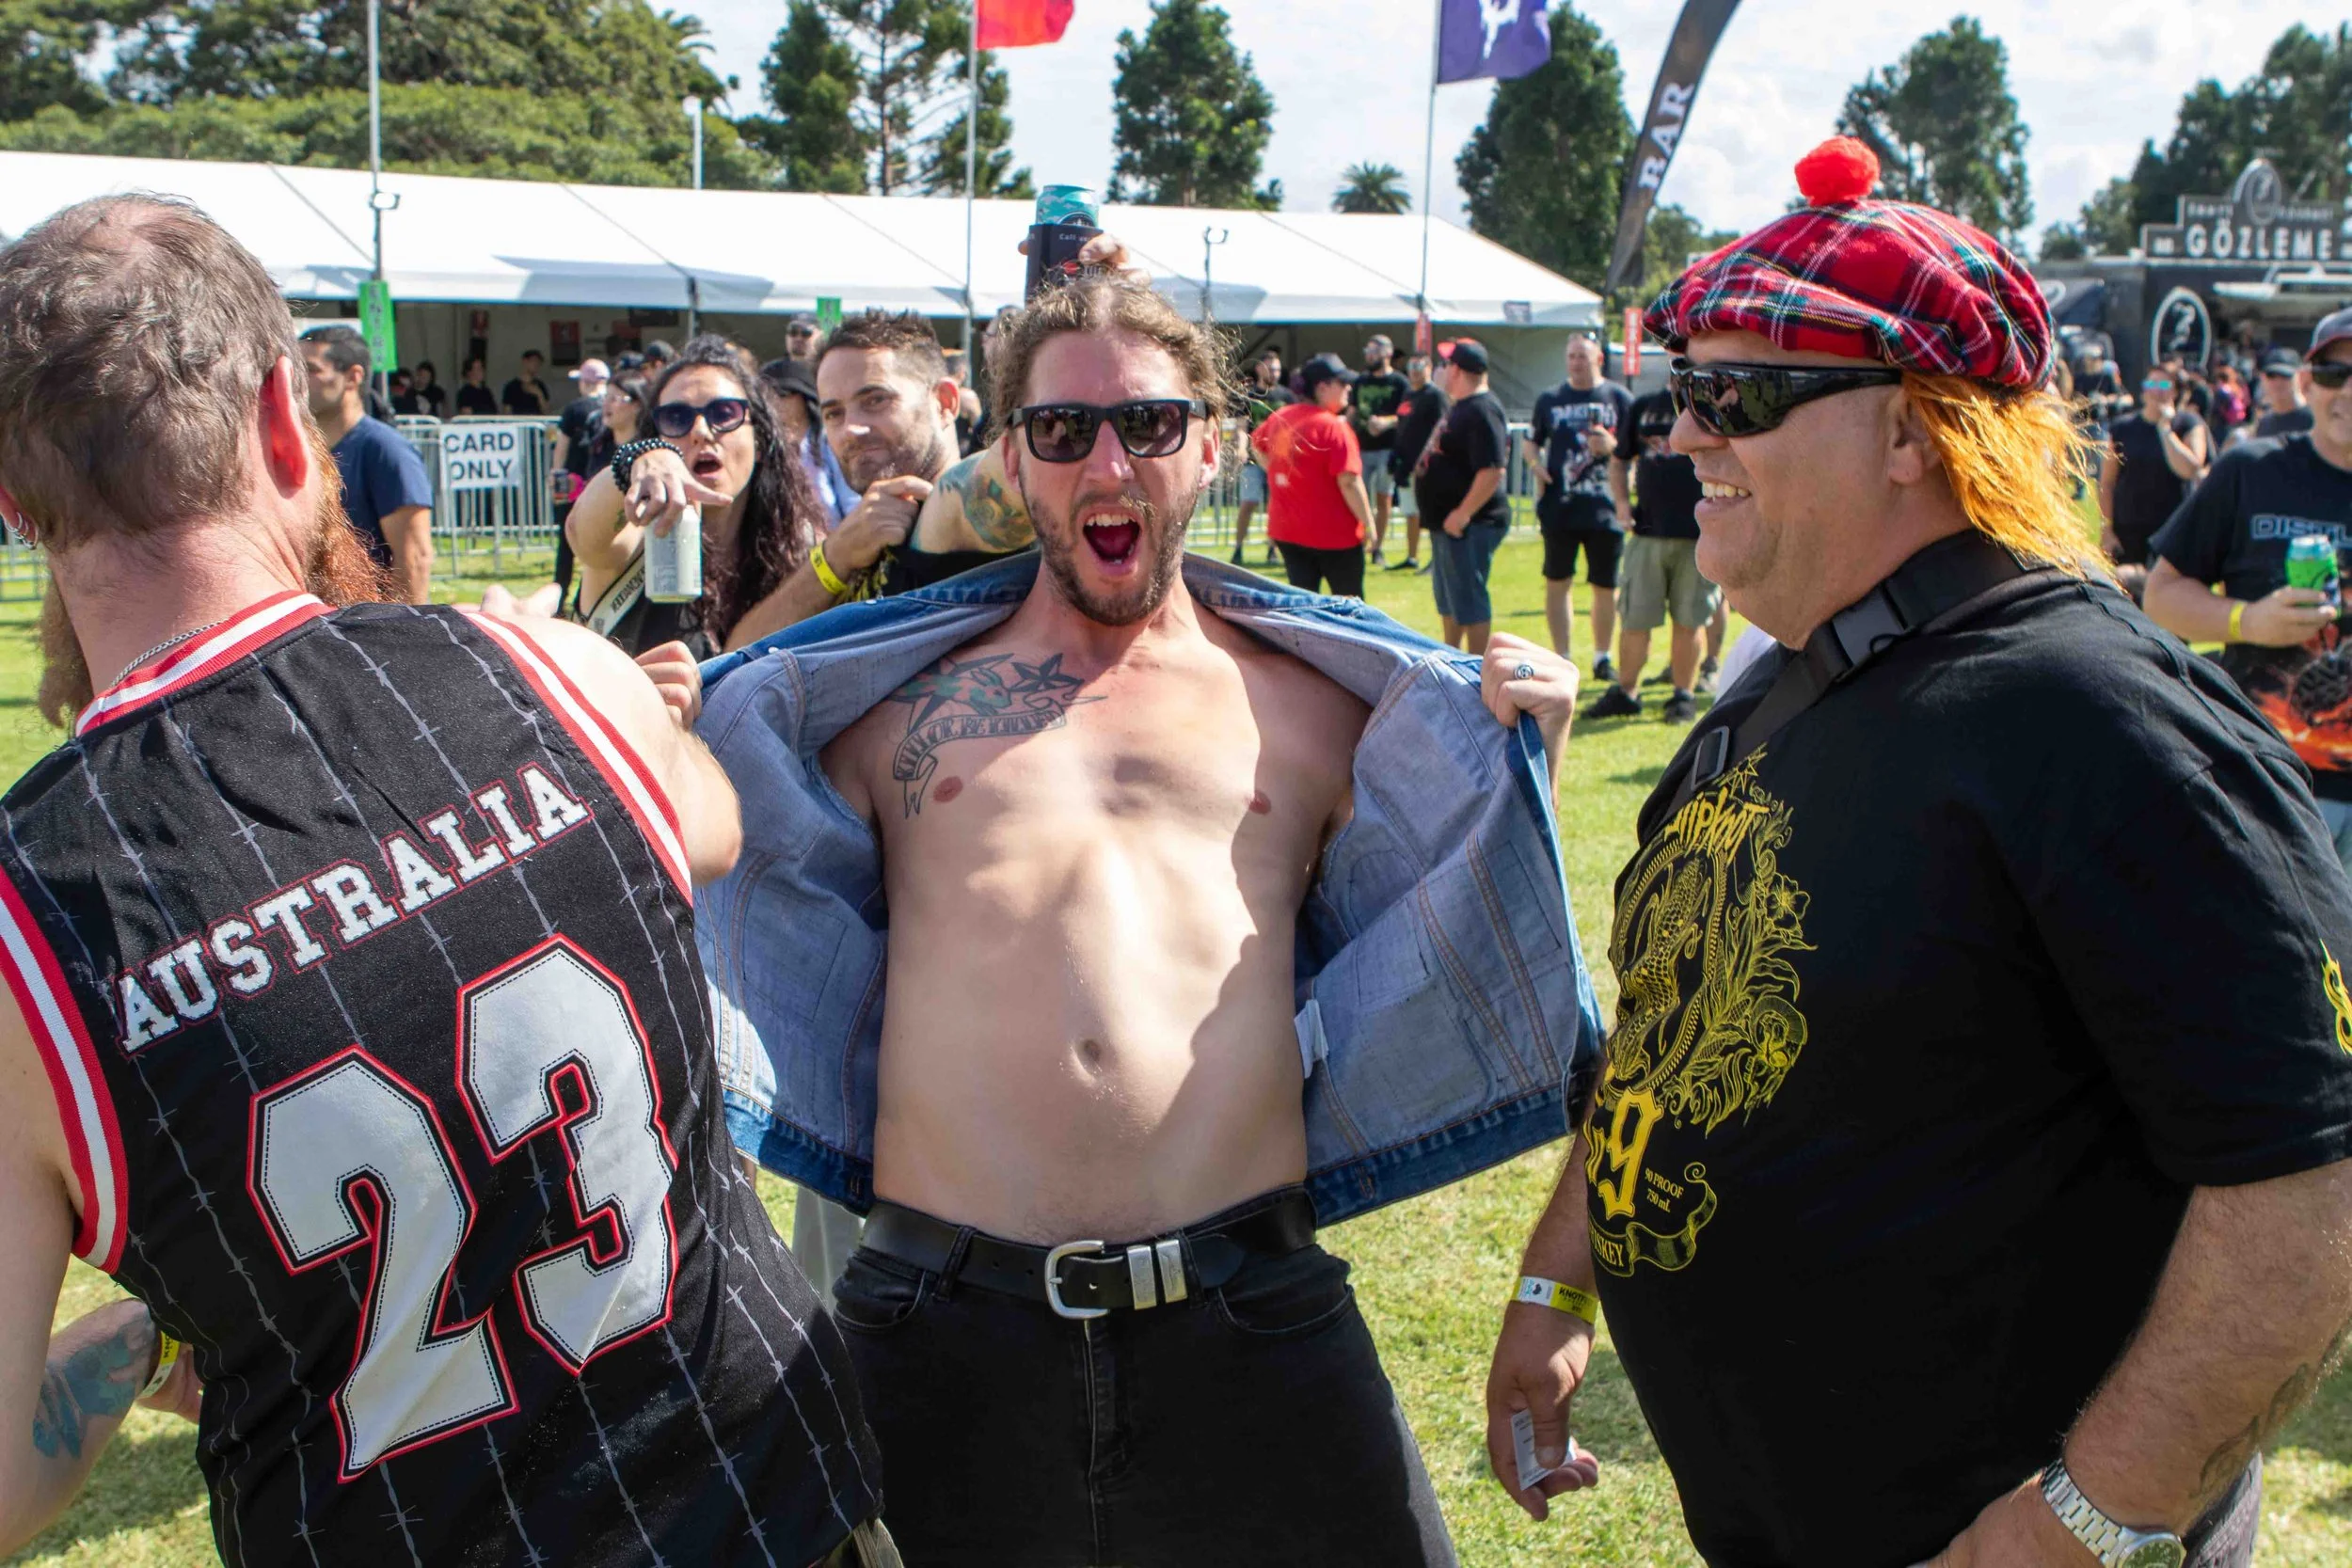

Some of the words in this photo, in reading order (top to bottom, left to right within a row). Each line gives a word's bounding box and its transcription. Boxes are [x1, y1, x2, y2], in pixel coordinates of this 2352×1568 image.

[1638, 83, 1694, 189] BAR
[2185, 216, 2333, 260] GÖZLEME
[443, 433, 515, 453] CARD
[451, 458, 512, 481] ONLY
[115, 761, 595, 1059] AUSTRALIA
[1646, 1188, 1660, 1206] 750
[1653, 1175, 1685, 1198] PROOF
[247, 933, 680, 1484] 23
